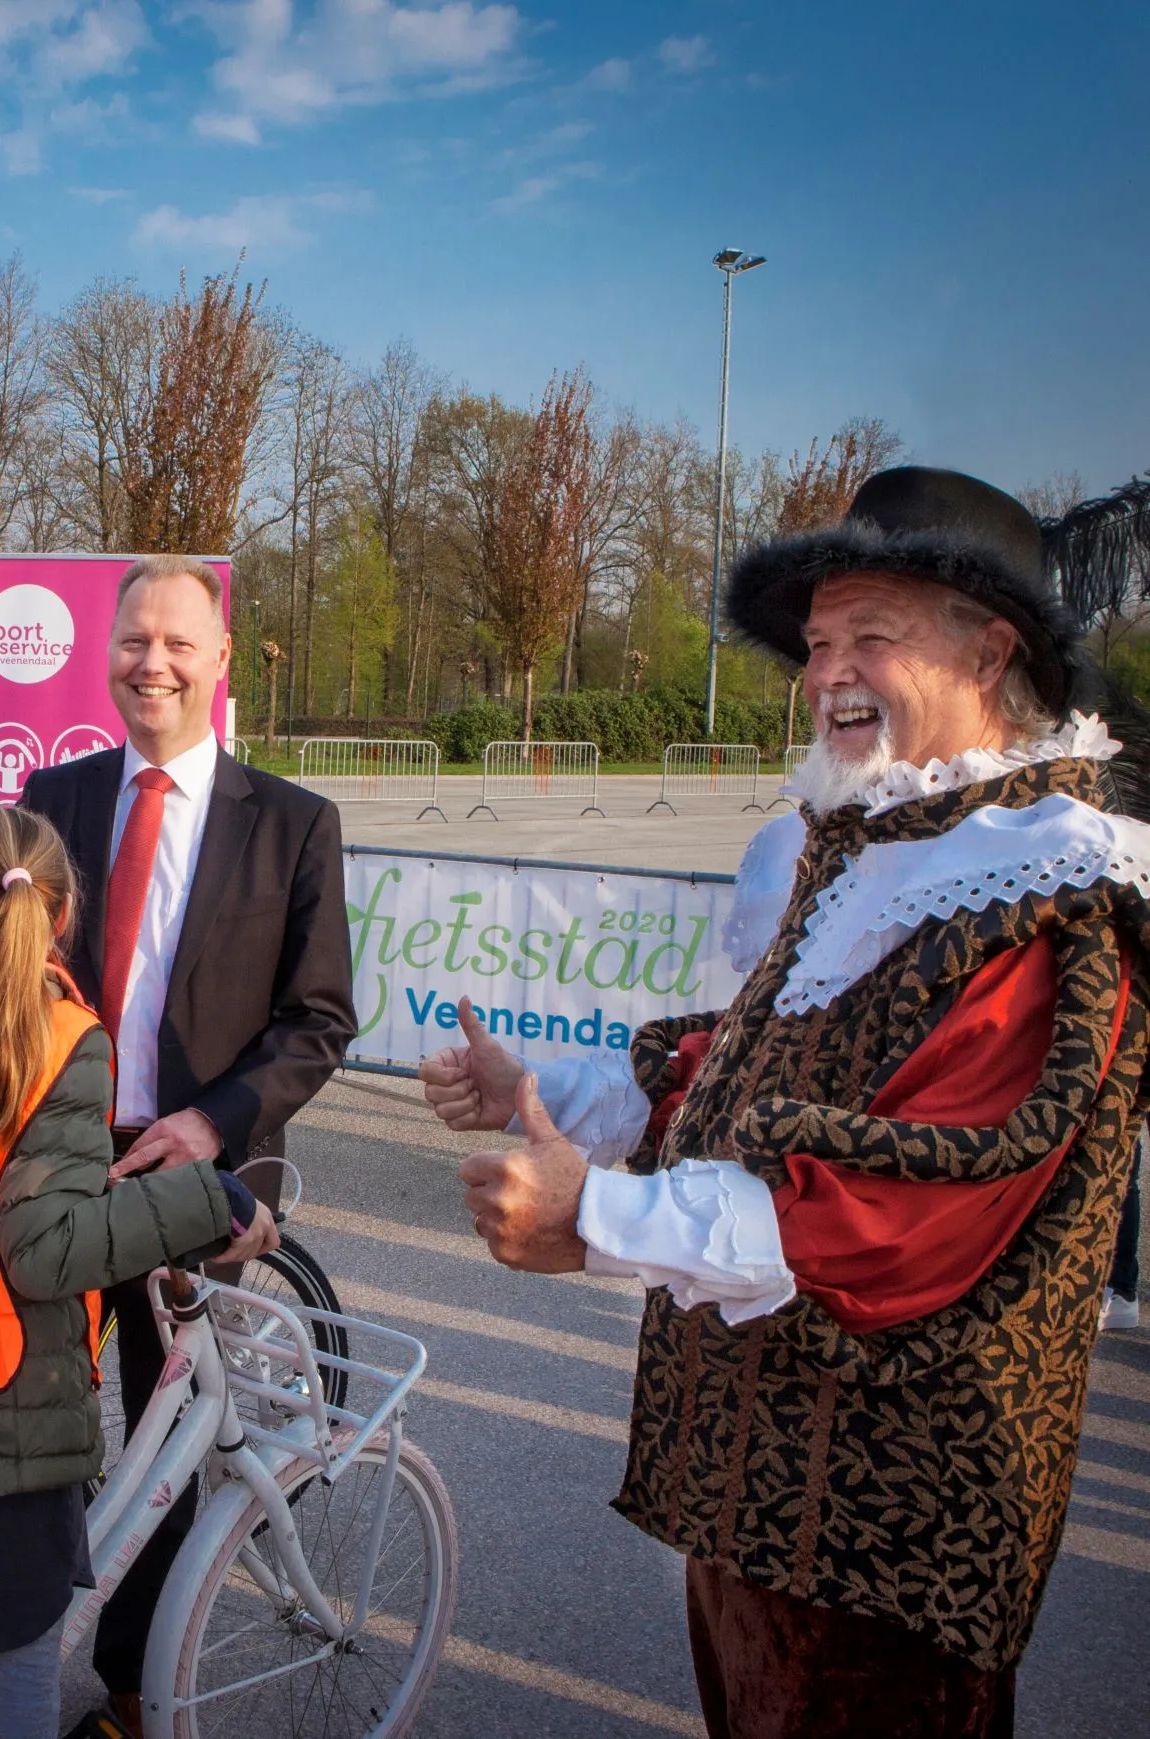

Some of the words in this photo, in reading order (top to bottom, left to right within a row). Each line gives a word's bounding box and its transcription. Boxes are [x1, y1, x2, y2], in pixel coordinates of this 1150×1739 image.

[0, 638, 74, 656] service
[0, 655, 56, 666] veenendaal
[599, 909, 676, 936] 2020
[347, 867, 710, 1002] fietsstad
